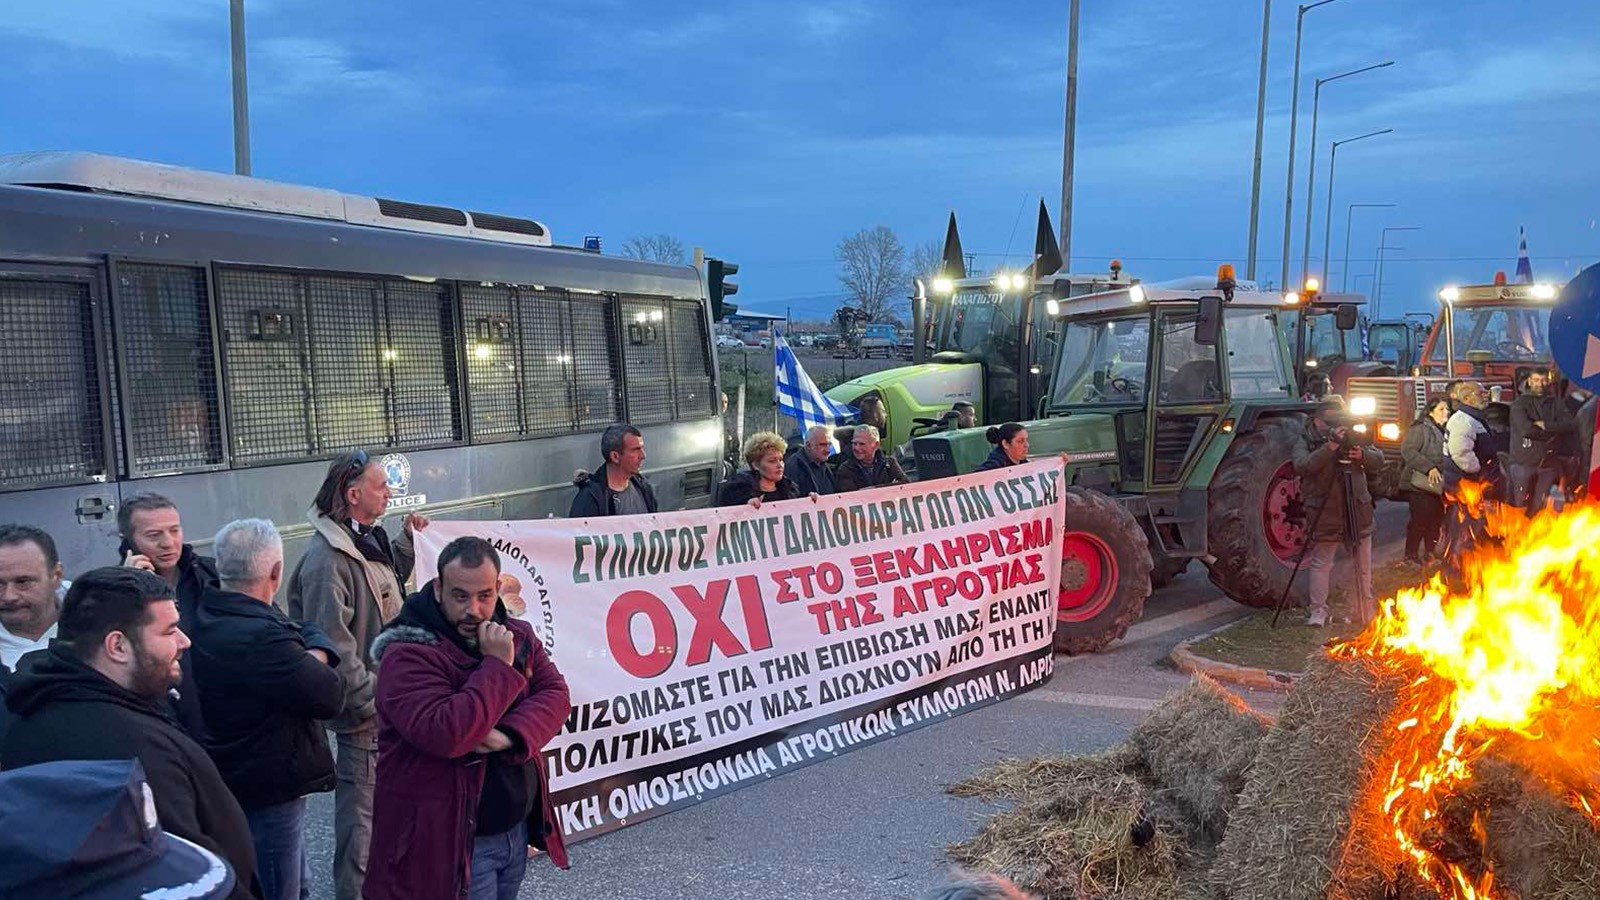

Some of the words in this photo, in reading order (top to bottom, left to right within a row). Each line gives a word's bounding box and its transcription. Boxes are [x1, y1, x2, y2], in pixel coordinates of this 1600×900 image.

[386, 496, 421, 508] OLICE
[573, 525, 709, 584] ΣΥΛΛΟΓΟΣ
[716, 485, 995, 566] ΑΜΥΓΔΑΛΟΠΑΡΑΓΩΓΩΝ
[994, 469, 1058, 513] ΟΣΣΑΣ
[606, 574, 773, 678] ΟΧΙ
[771, 562, 844, 604] ΣΤΟ
[808, 592, 884, 635] ΤΗΣ
[892, 554, 1046, 617] ΑΓΡΟΤΙΑΣ
[705, 701, 754, 737] ΠΟΥ
[762, 686, 812, 720] ΜΑΣ
[819, 650, 941, 703] ΔΙΩΧΝΟΥΝ
[947, 636, 984, 667] ΑΠΟ
[988, 627, 1017, 652] ΤΗ
[1021, 618, 1044, 644] ΓΗ
[718, 665, 757, 696] ΓΙΑ
[760, 651, 810, 684] ΤΗΝ
[816, 623, 929, 671] ΕΠΙΒΙΩΣΗ
[608, 747, 776, 819] ΟΜΟΣΠΟΝΔΙΑ
[777, 708, 897, 767] ΑΓΡΟΤΙΚΩΝ
[898, 674, 994, 727] ΣΥΛΛΟΓΩΝ
[996, 668, 1016, 693] Ν.
